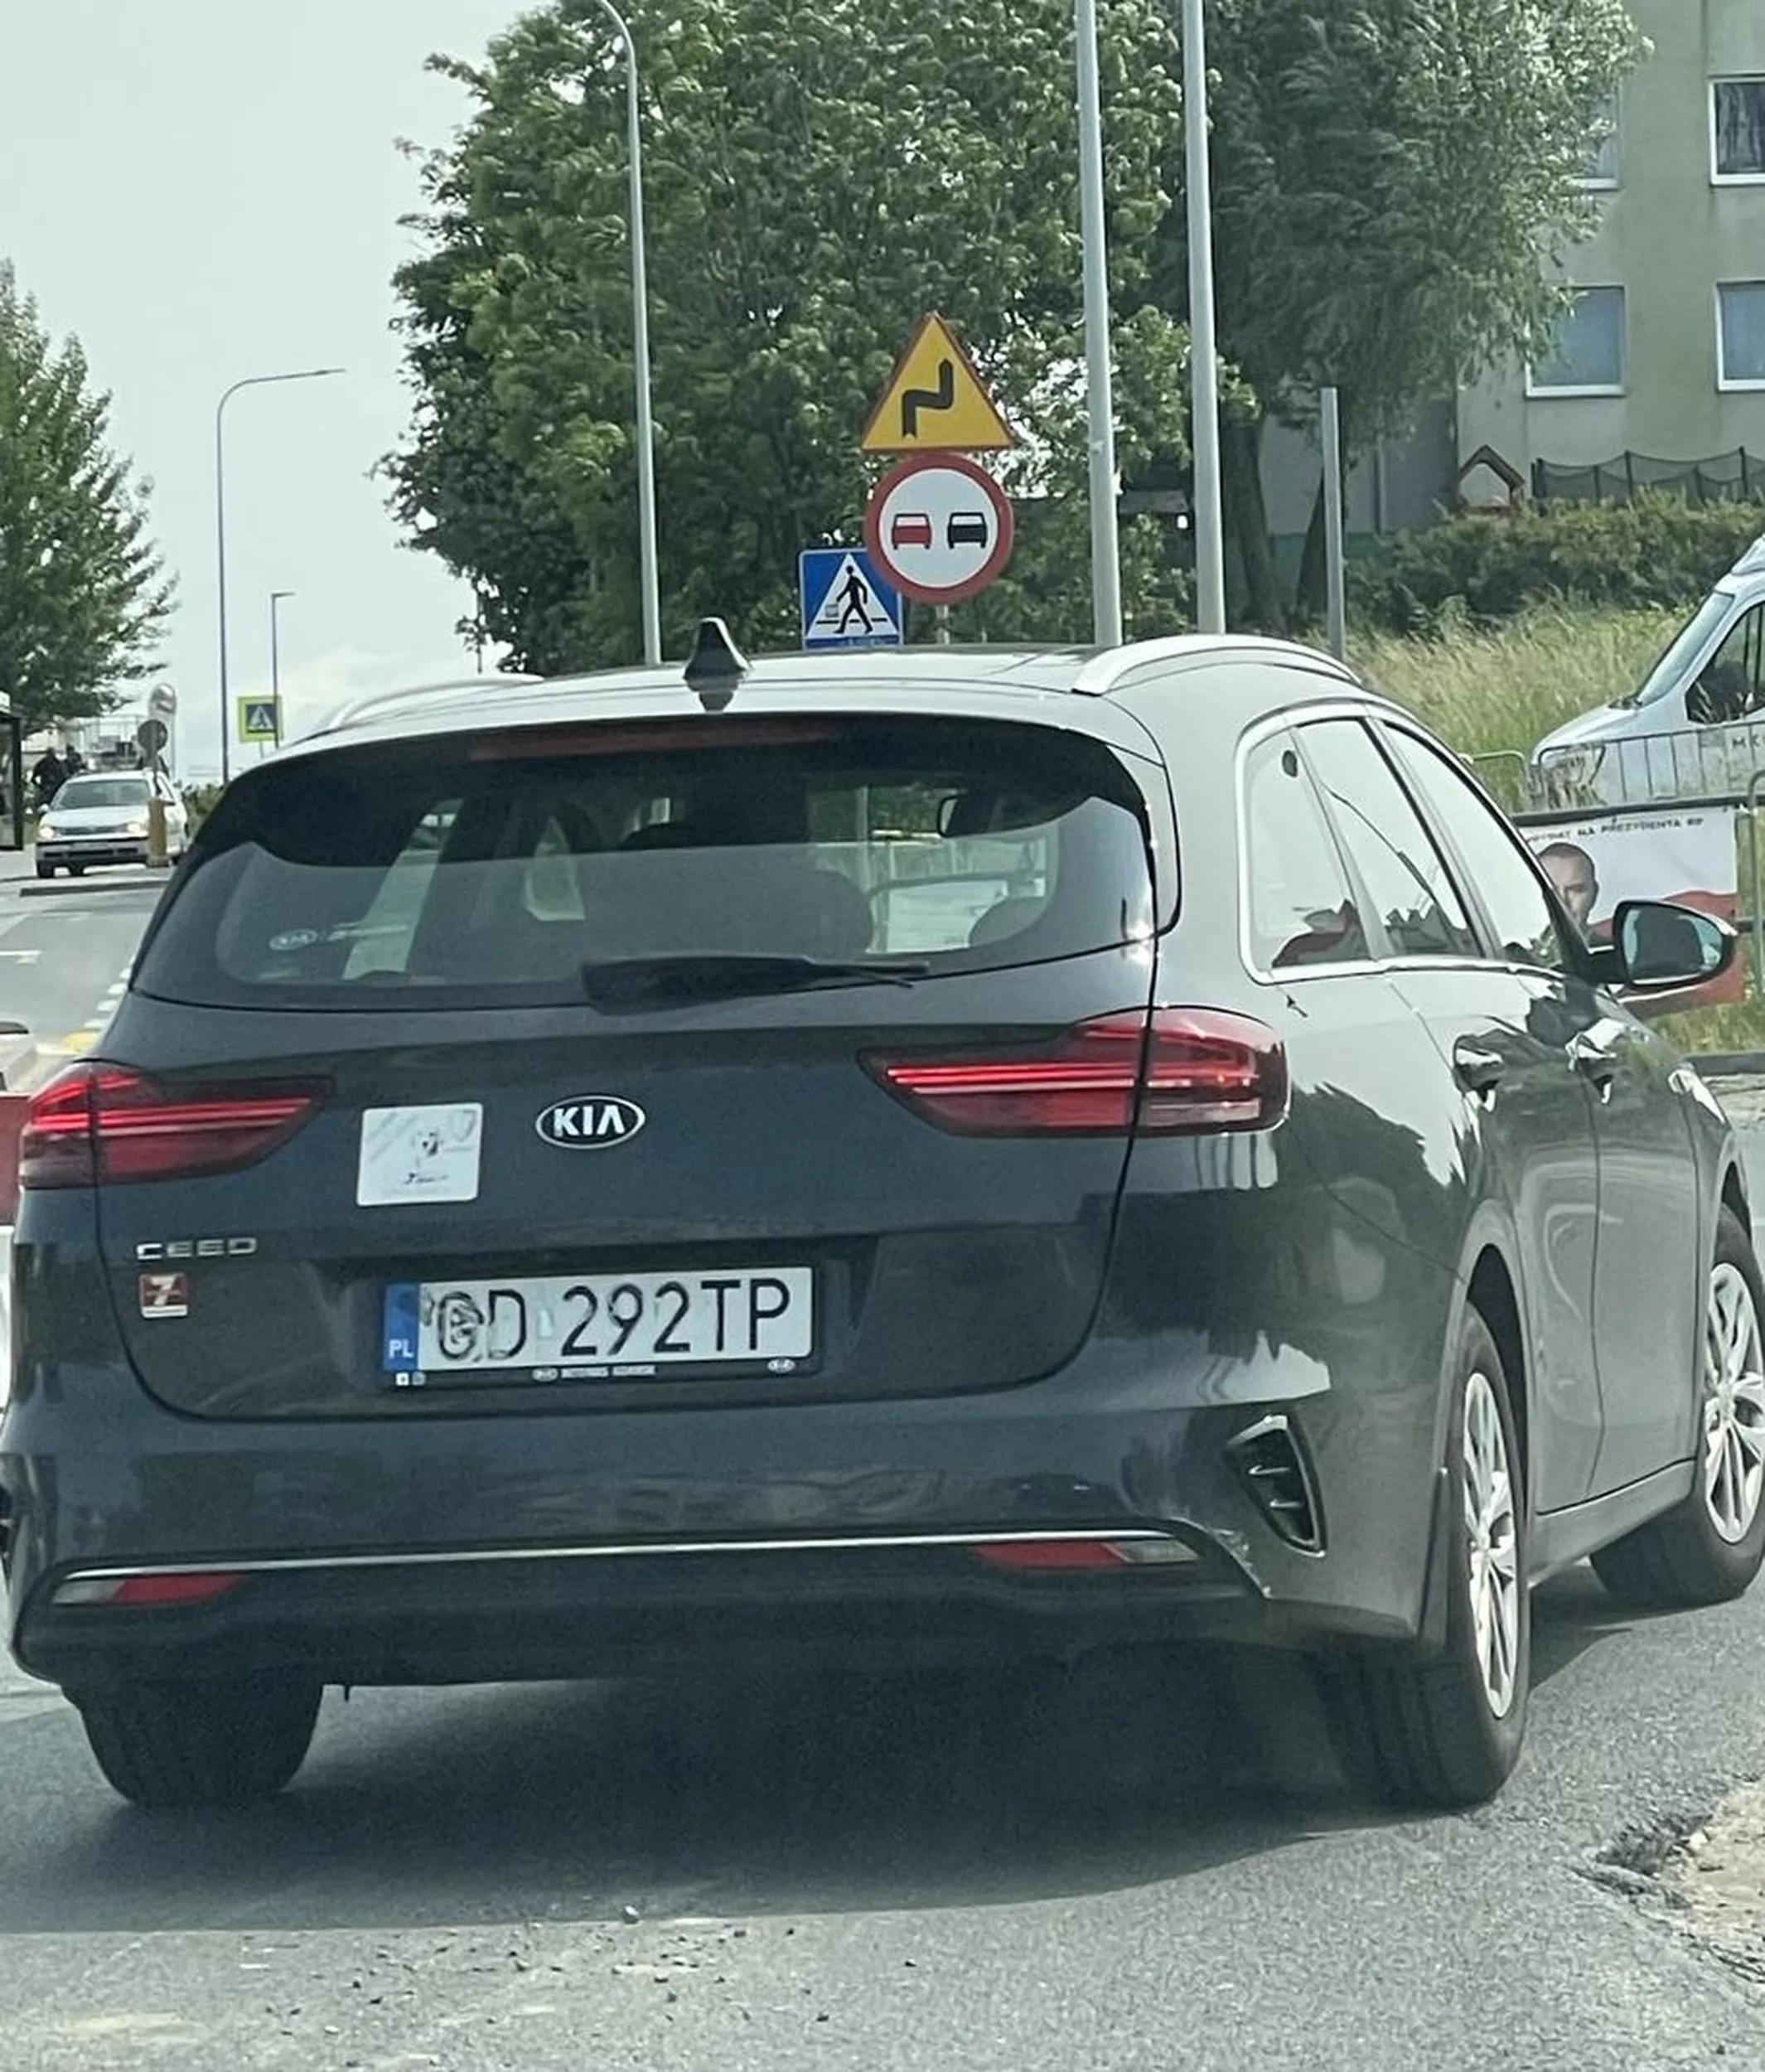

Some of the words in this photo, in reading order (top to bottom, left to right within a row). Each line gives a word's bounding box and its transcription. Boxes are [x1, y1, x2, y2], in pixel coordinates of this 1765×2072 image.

[554, 1104, 626, 1137] KIA
[137, 1237, 257, 1260] CEED
[561, 1277, 790, 1358] 292TP
[388, 1339, 414, 1358] PL
